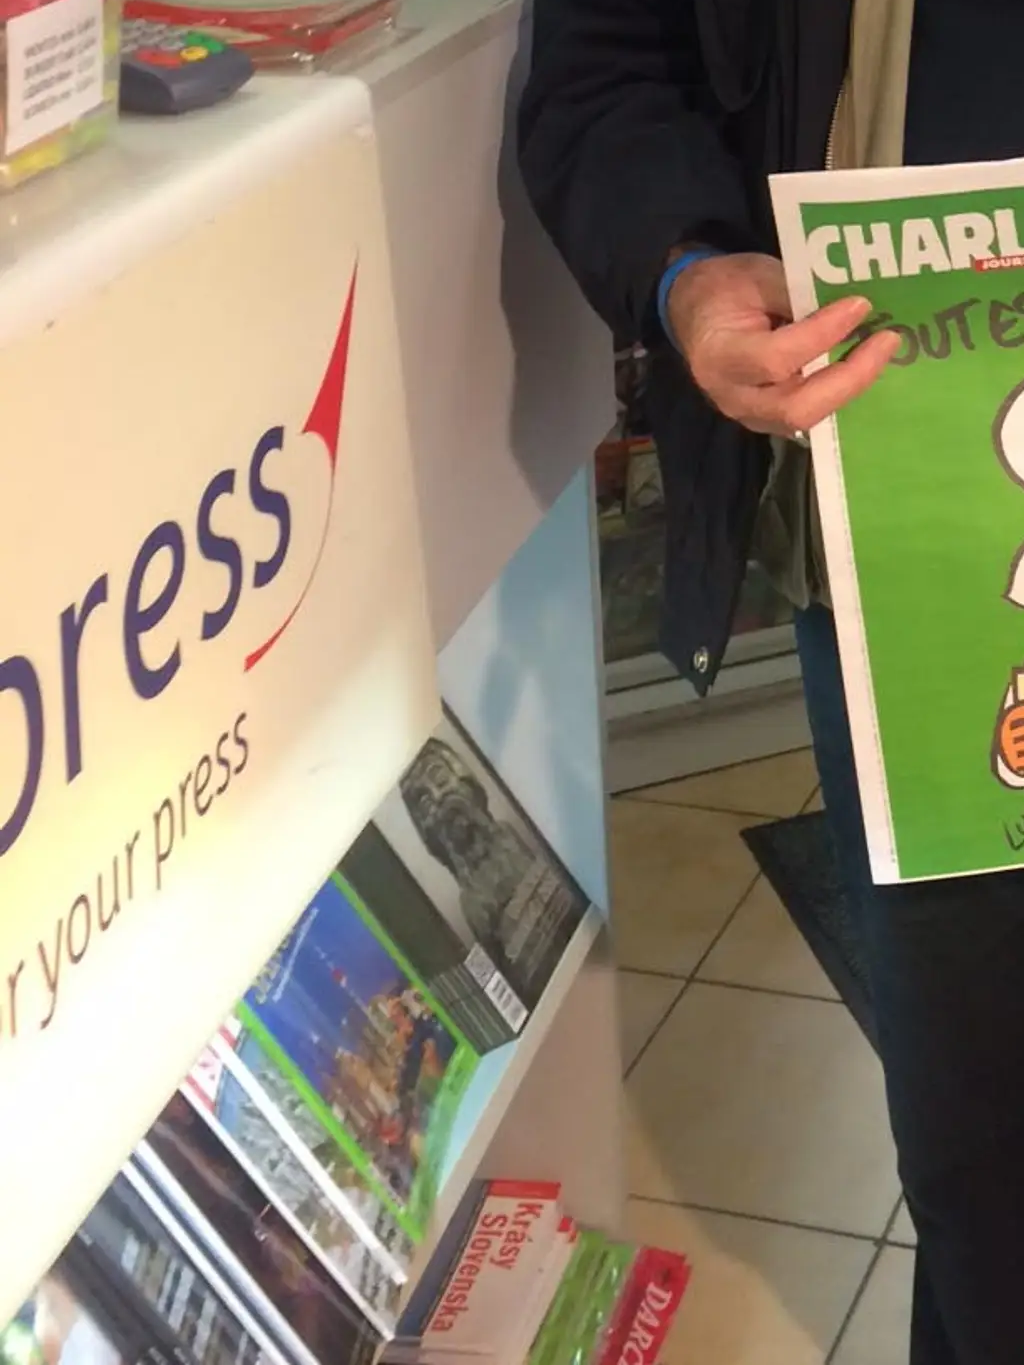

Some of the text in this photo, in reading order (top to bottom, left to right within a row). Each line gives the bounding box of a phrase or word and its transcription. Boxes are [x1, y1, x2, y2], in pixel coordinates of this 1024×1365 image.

[37, 824, 140, 1032] your
[155, 709, 250, 891] press
[432, 1213, 508, 1332] Slovenska
[491, 1202, 544, 1270] Krásy
